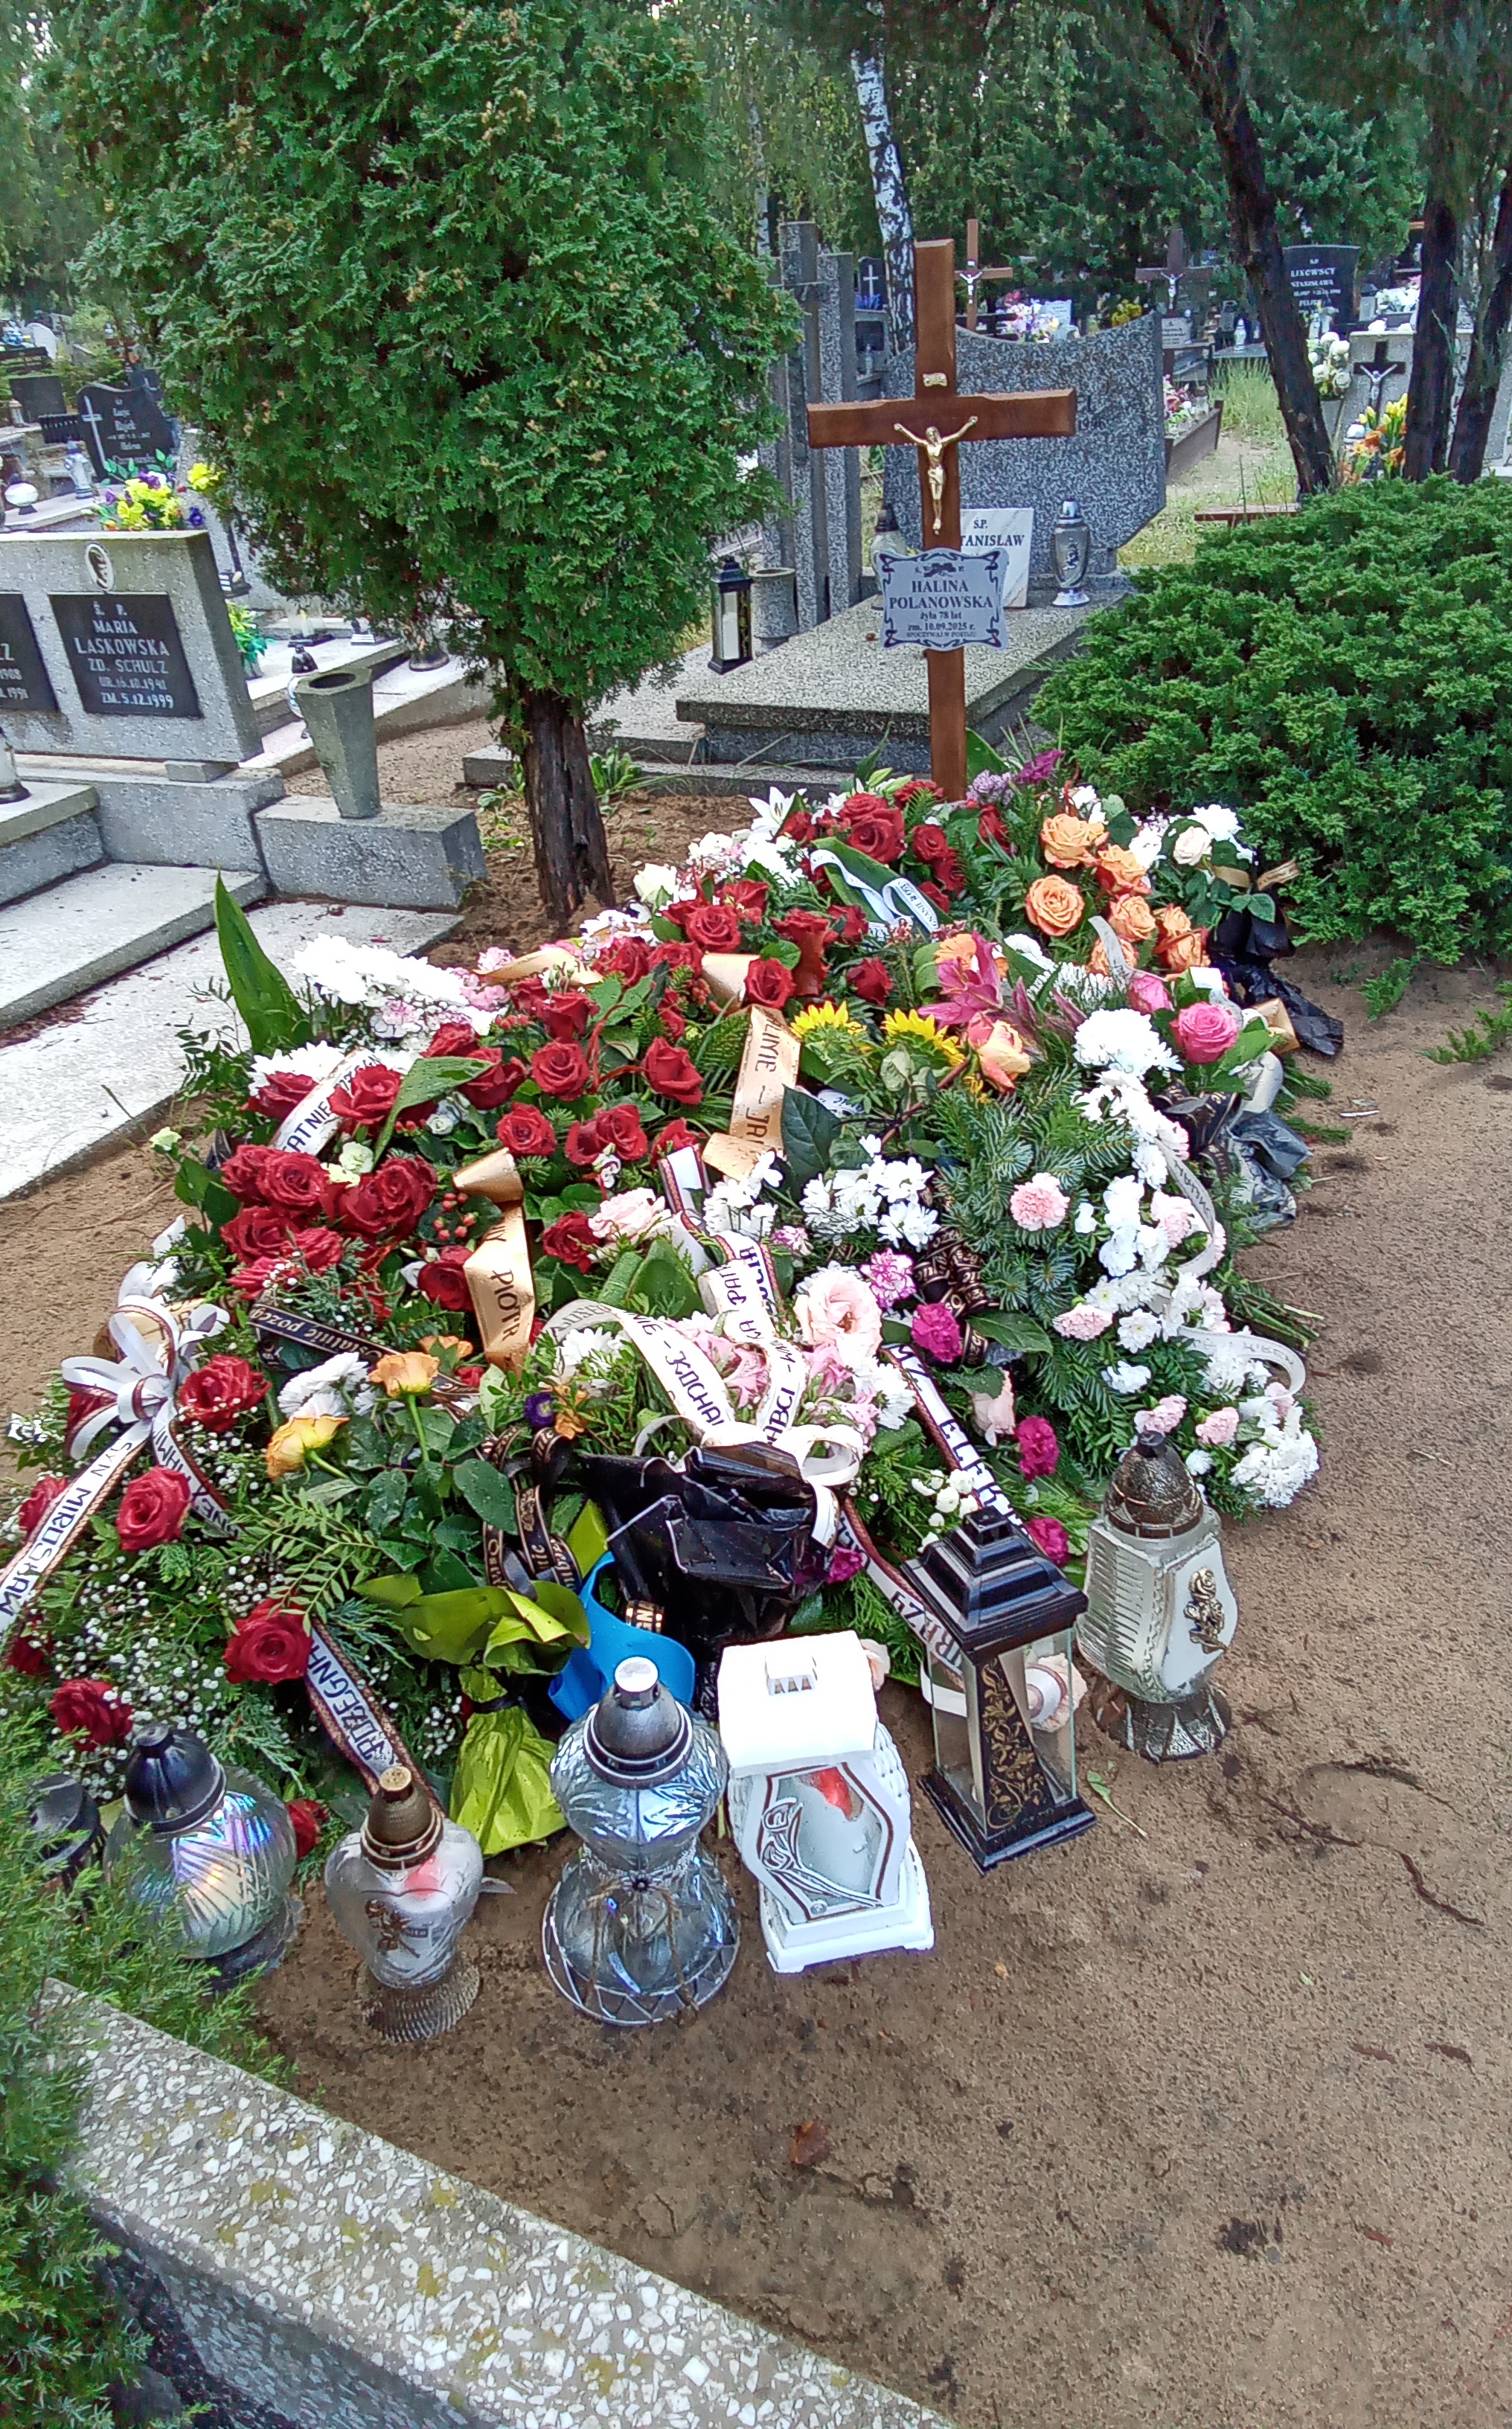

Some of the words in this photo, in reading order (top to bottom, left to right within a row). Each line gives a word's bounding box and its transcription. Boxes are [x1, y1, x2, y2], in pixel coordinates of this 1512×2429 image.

[912, 579, 970, 593] HALINA
[888, 595, 994, 610] POLANOWSKA
[951, 610, 962, 620] lat
[92, 620, 138, 634] MARIA
[73, 637, 170, 656] LASKOWSKA
[115, 659, 170, 674] SCHULZ
[490, 1268, 522, 1342] PIOTR
[89, 1441, 133, 1479] SYN
